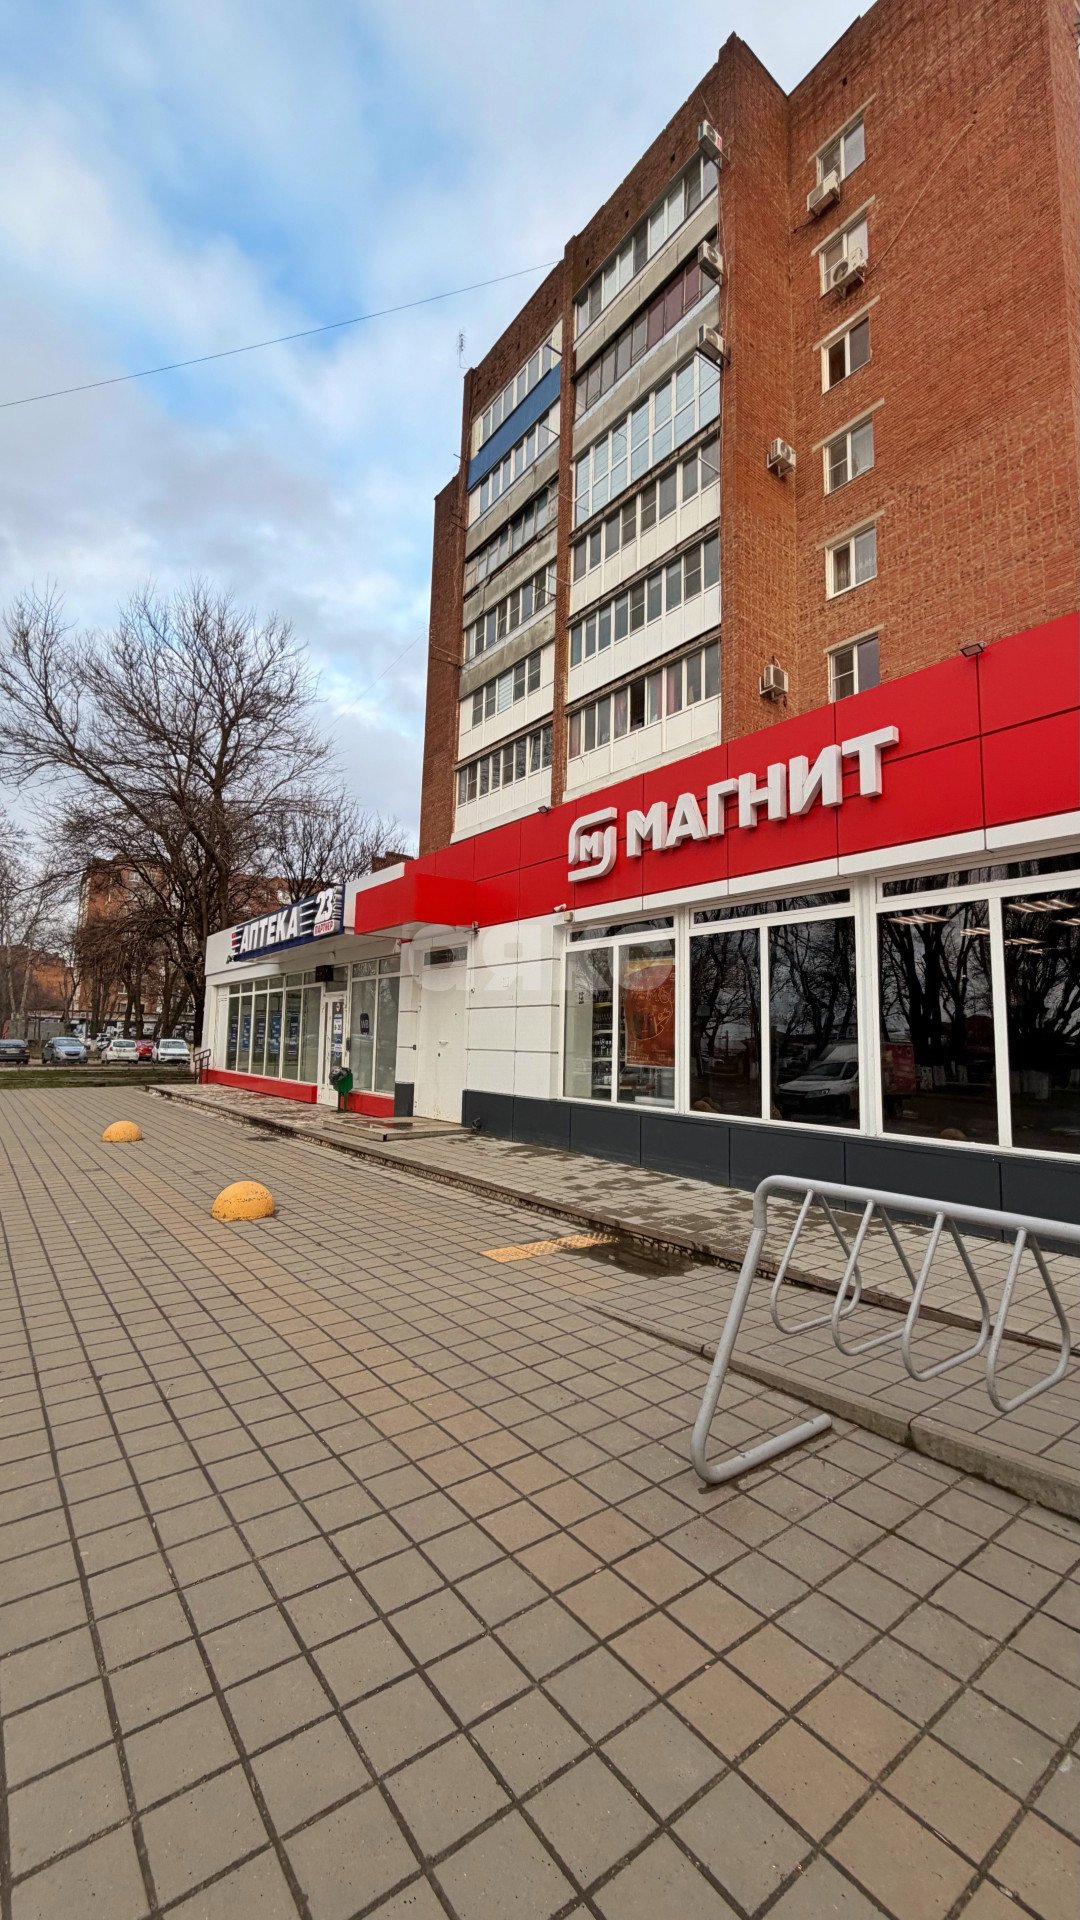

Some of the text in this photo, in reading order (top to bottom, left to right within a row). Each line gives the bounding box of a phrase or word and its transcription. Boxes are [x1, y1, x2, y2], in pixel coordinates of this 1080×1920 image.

[626, 725, 899, 858] МАГНИТ
[239, 906, 300, 954] АПТЕКА
[314, 888, 334, 924] 23
